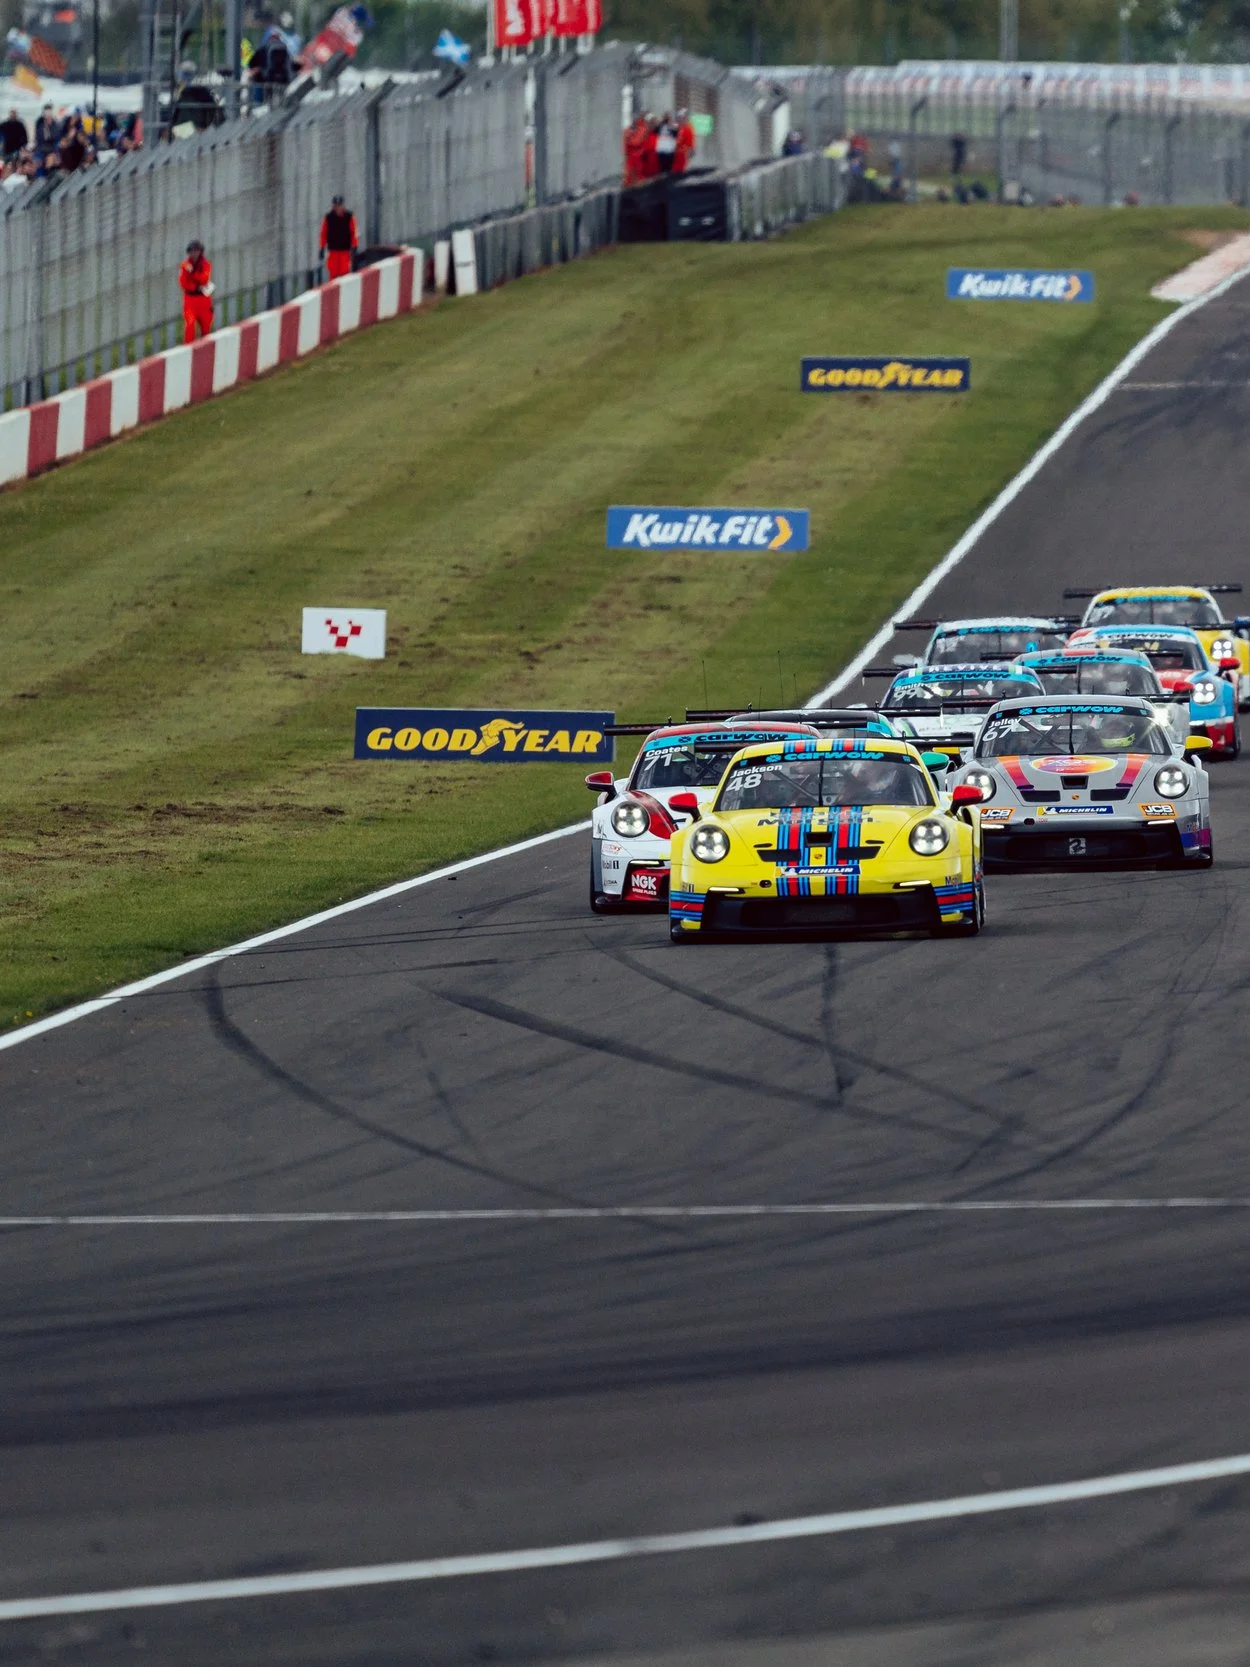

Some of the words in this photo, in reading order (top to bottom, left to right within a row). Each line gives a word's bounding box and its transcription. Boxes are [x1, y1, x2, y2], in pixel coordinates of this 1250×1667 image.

[808, 364, 964, 387] GOODYEAR
[934, 672, 1012, 680] carwow
[1035, 704, 1124, 714] carwow
[366, 720, 602, 754] GOODYEAR
[695, 731, 788, 742] carwow
[982, 725, 1012, 742] 67
[646, 745, 688, 757] Coates
[784, 751, 885, 761] carwow
[644, 753, 673, 771] 71
[730, 764, 783, 779] Jackson
[725, 773, 762, 792] 48
[982, 809, 1011, 817] JCB
[1144, 805, 1174, 813] JCB
[798, 866, 854, 874] MICHELIN
[631, 874, 657, 890] NGK
